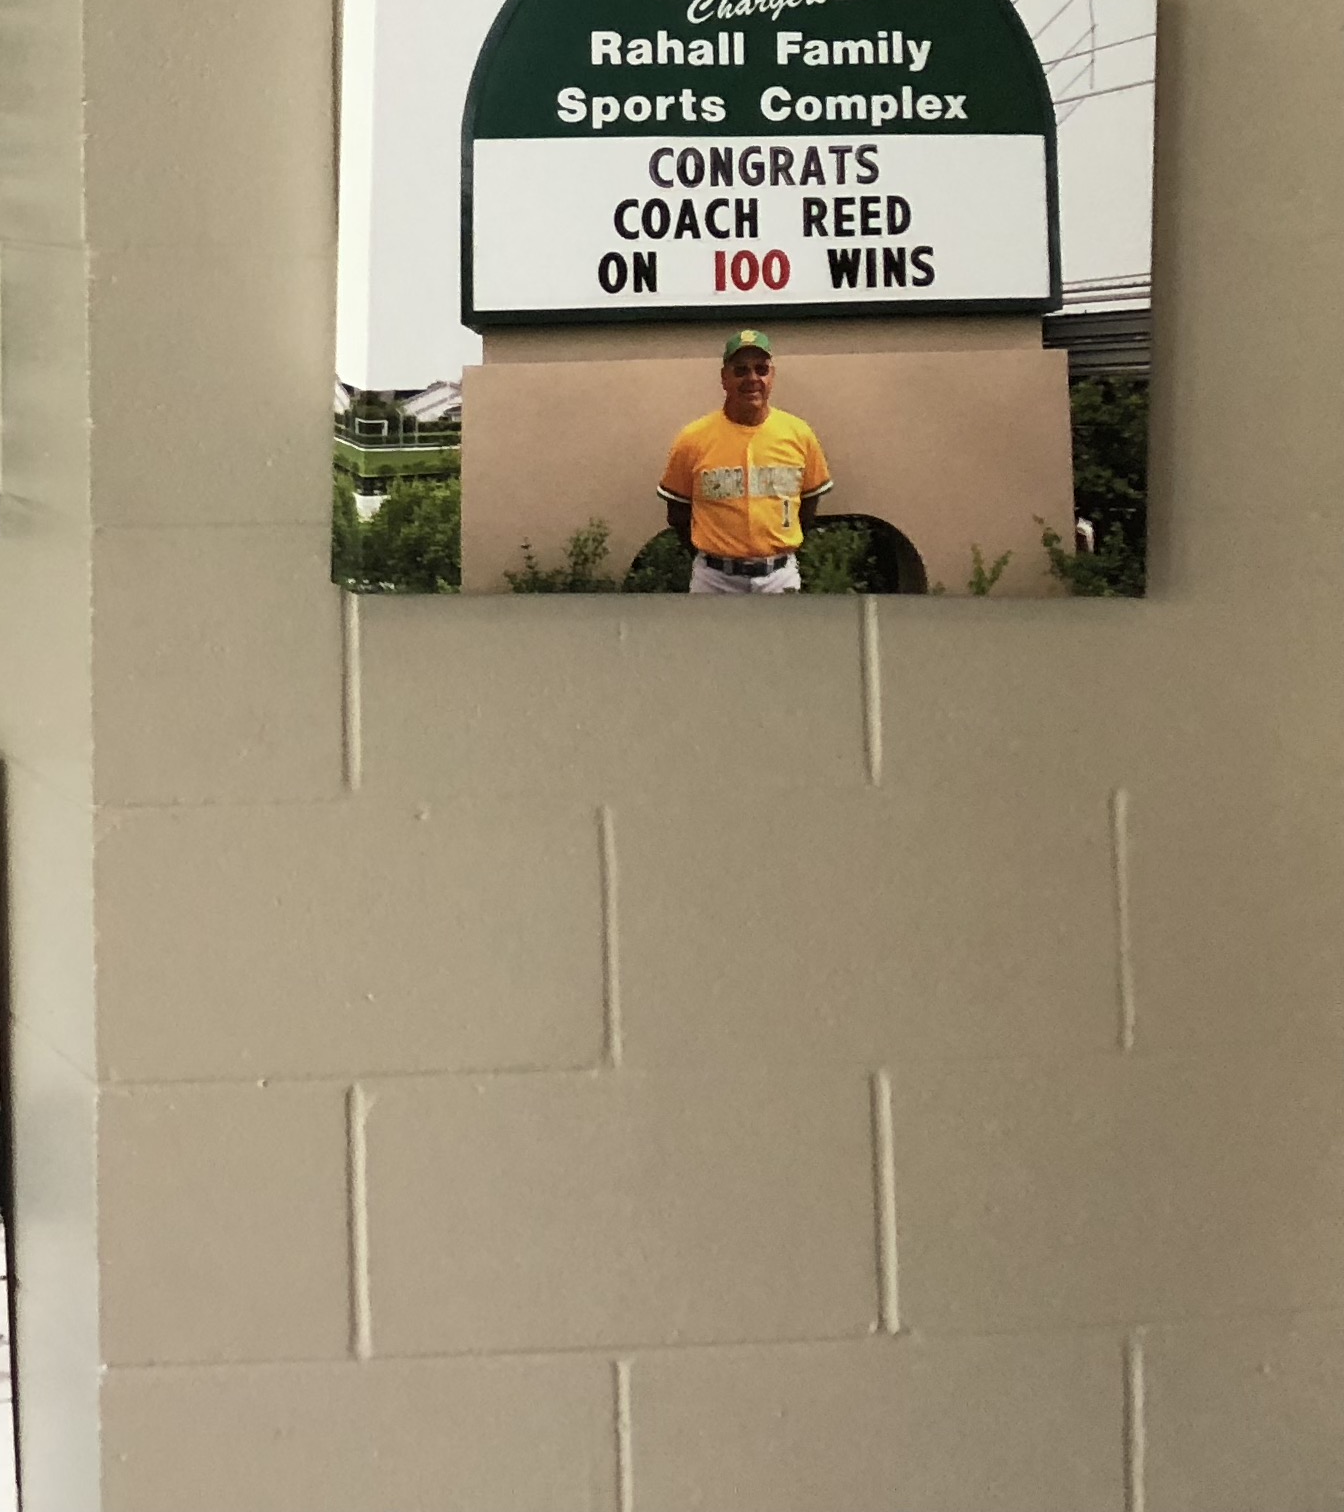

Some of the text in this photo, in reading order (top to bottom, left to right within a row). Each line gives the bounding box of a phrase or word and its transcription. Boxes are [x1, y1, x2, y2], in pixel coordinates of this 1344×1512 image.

[590, 30, 932, 72] Rahall Family
[557, 85, 968, 129] Sports Complex
[648, 144, 879, 188] CONGRATS
[613, 195, 912, 240] COACH REED
[598, 245, 936, 294] ON 100 WINS
